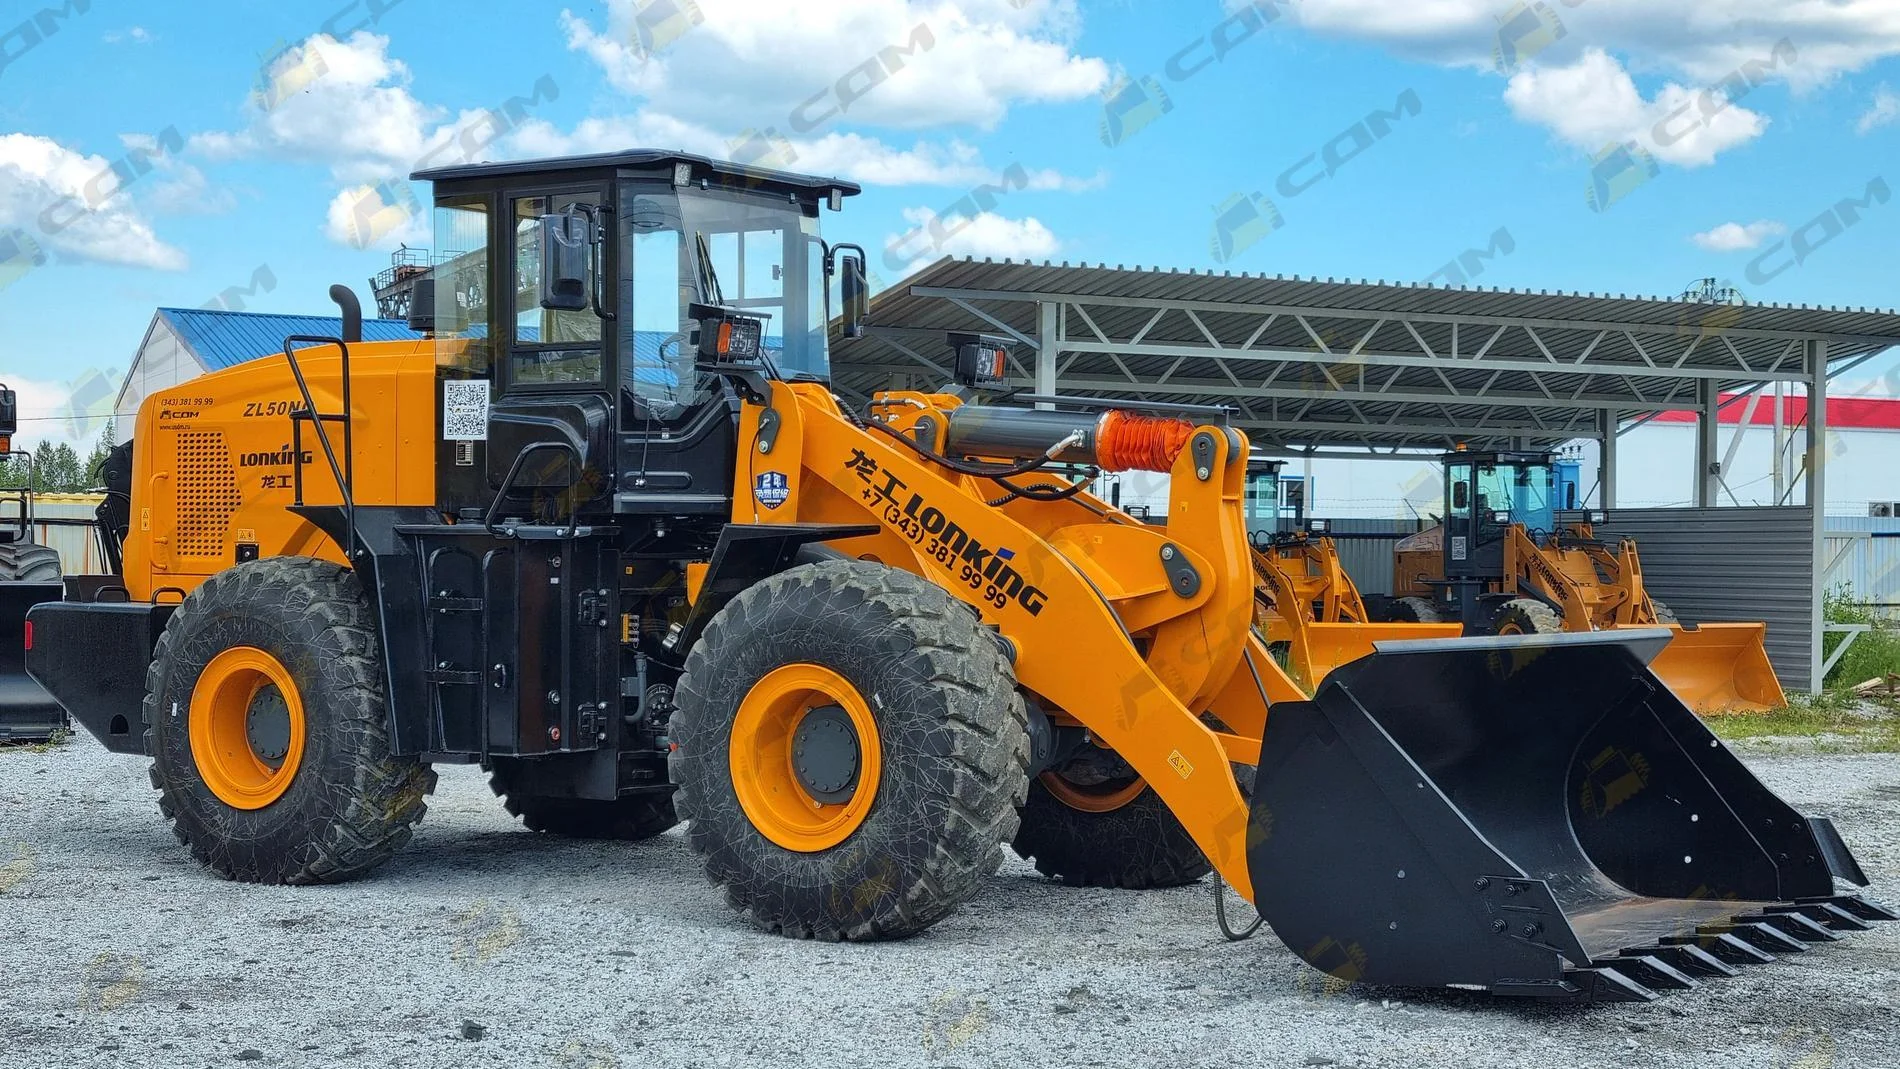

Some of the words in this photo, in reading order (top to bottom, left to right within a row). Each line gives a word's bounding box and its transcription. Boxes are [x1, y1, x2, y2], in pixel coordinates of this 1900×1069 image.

[179, 398, 192, 406] 381
[204, 397, 214, 405] 99
[243, 401, 314, 417] ZL50N
[261, 474, 293, 489] 龙工
[845, 448, 907, 507] 龙工
[862, 487, 883, 509] +7
[883, 503, 925, 546] (343)
[926, 537, 957, 571] 381
[960, 565, 983, 590] 99
[984, 585, 1007, 610] 99
